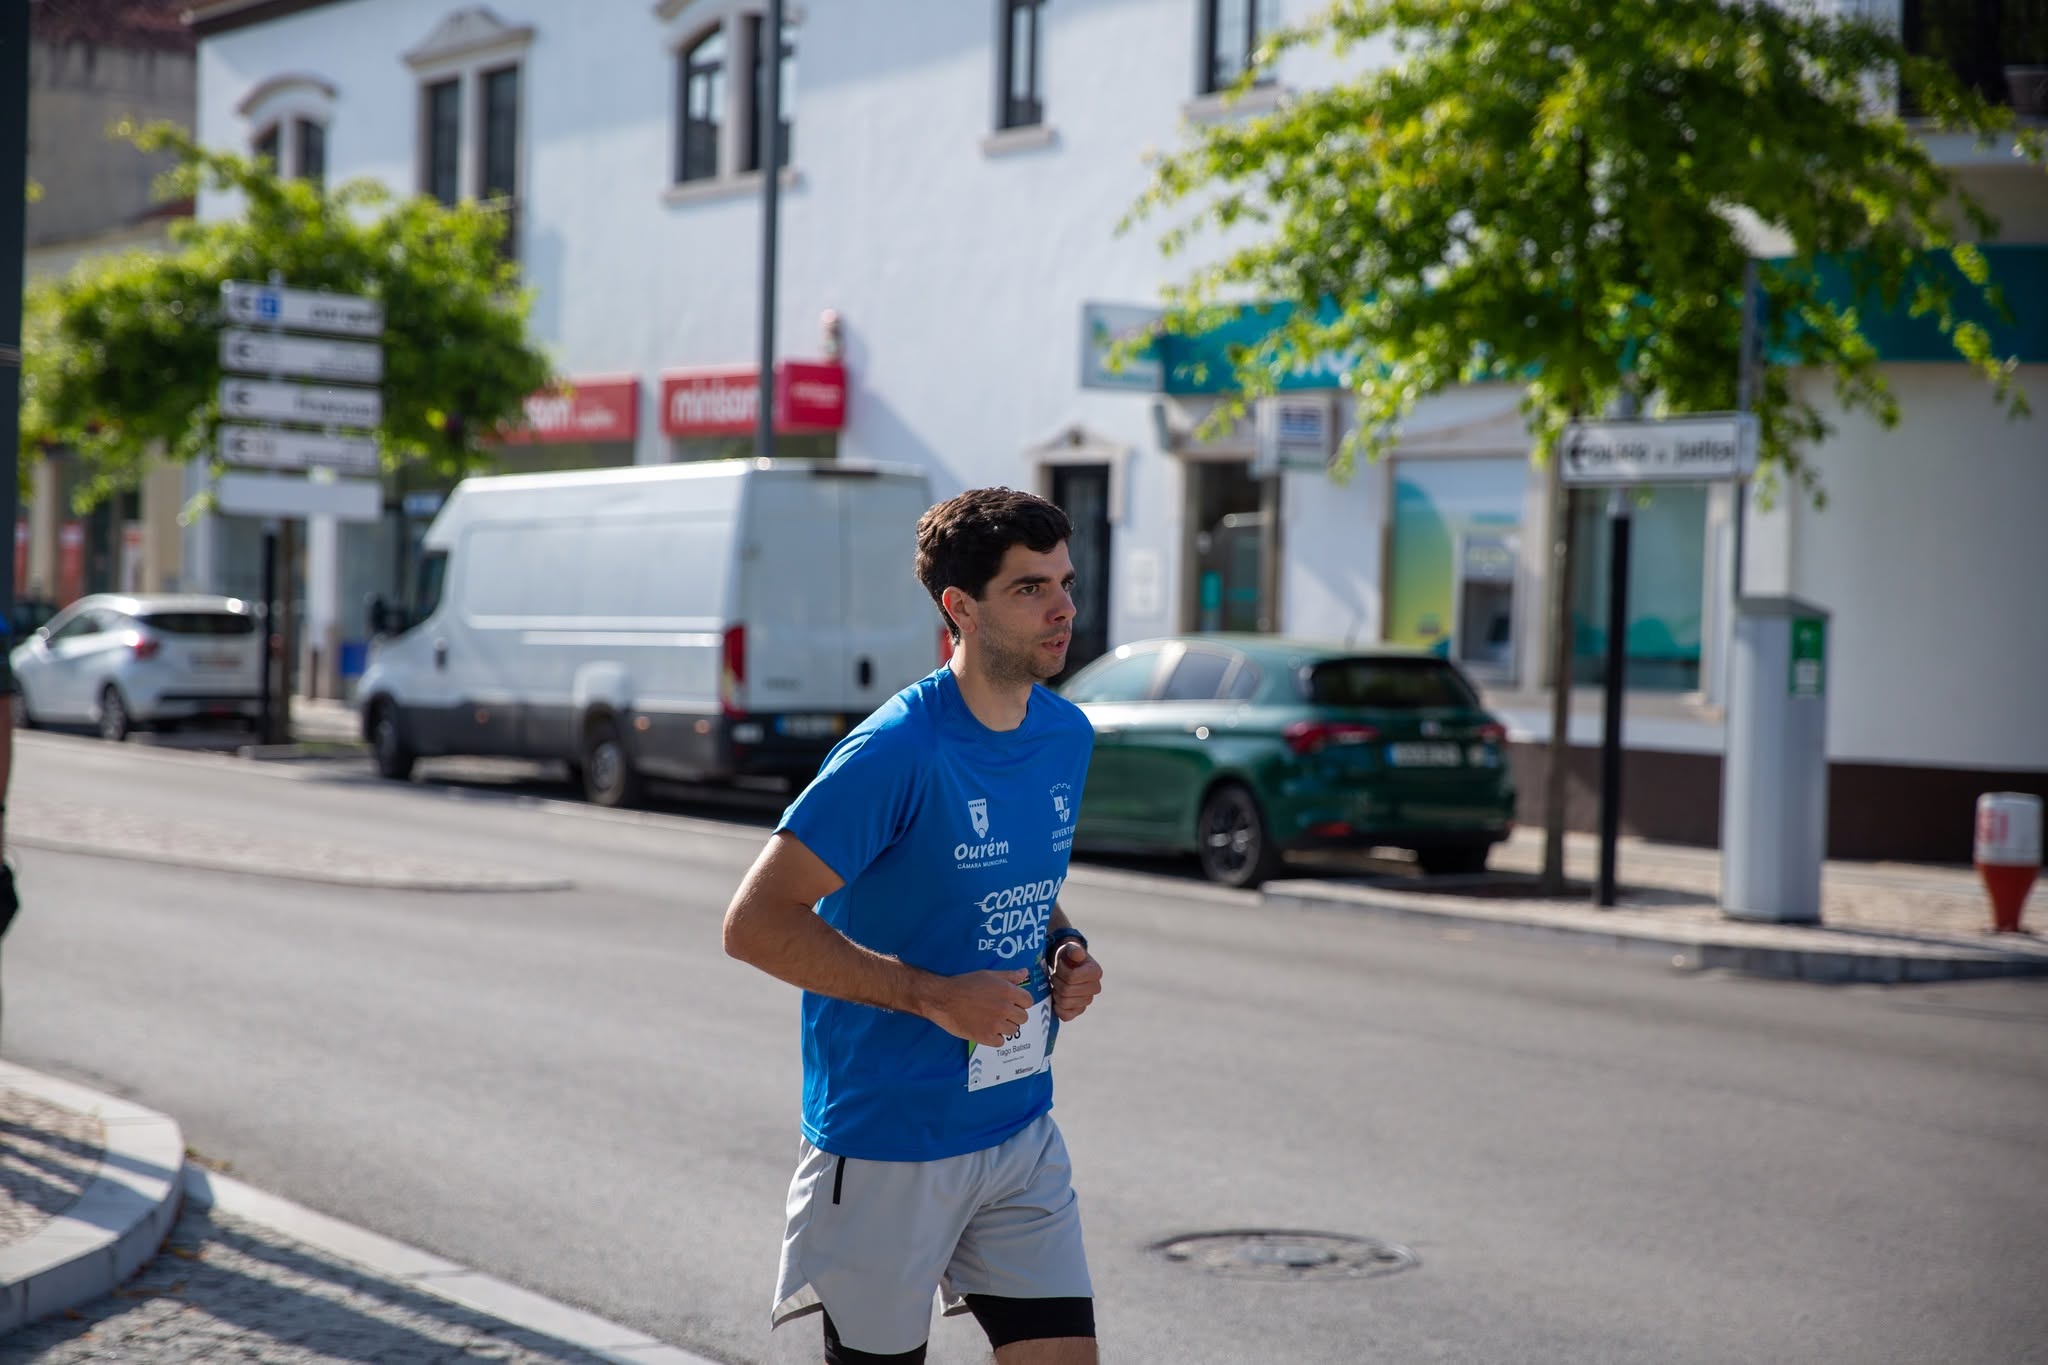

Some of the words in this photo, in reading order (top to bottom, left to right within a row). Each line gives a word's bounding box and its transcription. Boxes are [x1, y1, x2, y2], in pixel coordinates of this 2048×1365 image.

[954, 837, 1009, 861] Ourém
[983, 858, 1008, 867] MUNICIPAL
[978, 938, 996, 951] DE
